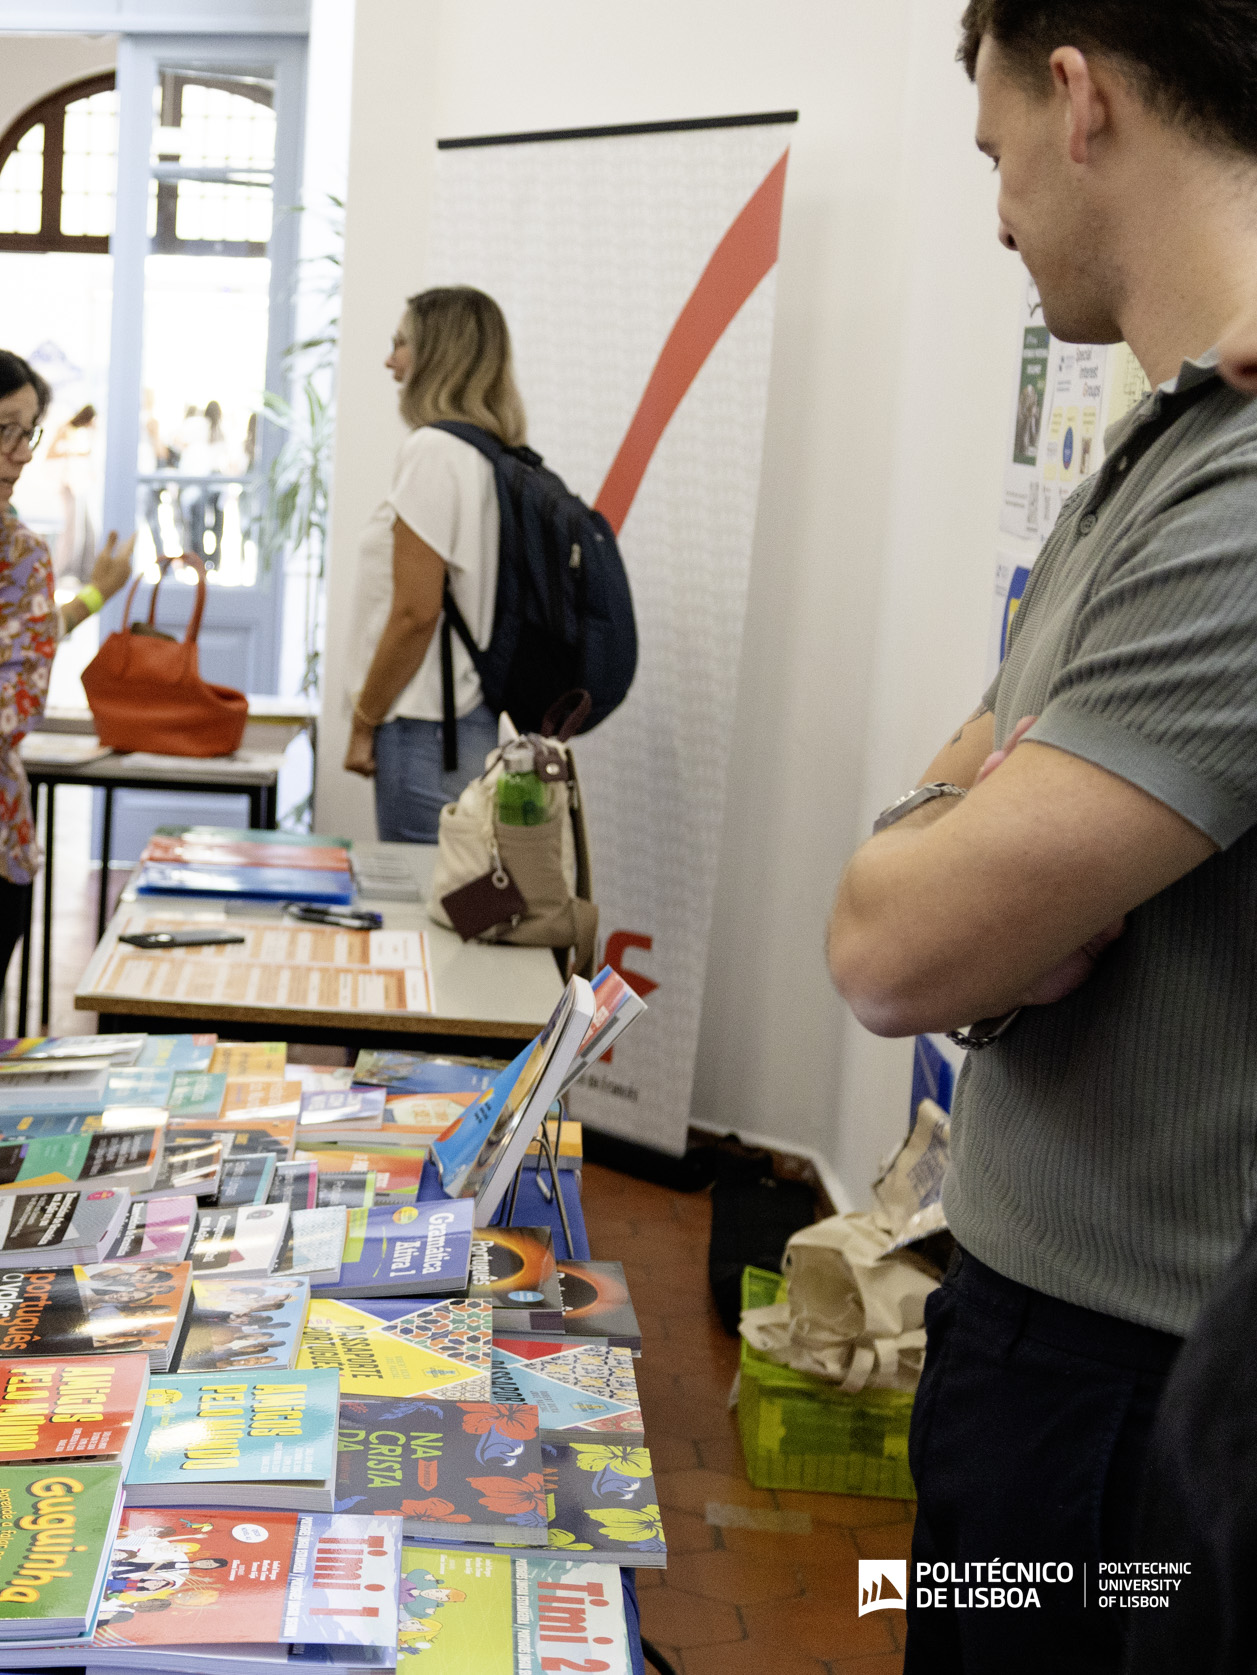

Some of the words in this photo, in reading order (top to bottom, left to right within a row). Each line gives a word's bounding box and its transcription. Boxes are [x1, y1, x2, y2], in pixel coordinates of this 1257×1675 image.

[392, 1241, 420, 1268] Ativa
[422, 1213, 454, 1274] Gramática
[470, 1241, 498, 1285] Português
[334, 1326, 383, 1379] PASSAPORTE
[3, 1368, 56, 1400] PELO
[197, 1384, 247, 1417] PELO
[492, 1361, 528, 1405] PASSAPOR
[366, 1430, 406, 1489] CRISTA
[410, 1432, 443, 1459] NA
[312, 1536, 388, 1592] Timi
[309, 1607, 379, 1617] 1
[537, 1582, 614, 1645] Timi
[541, 1657, 611, 1673] 2
